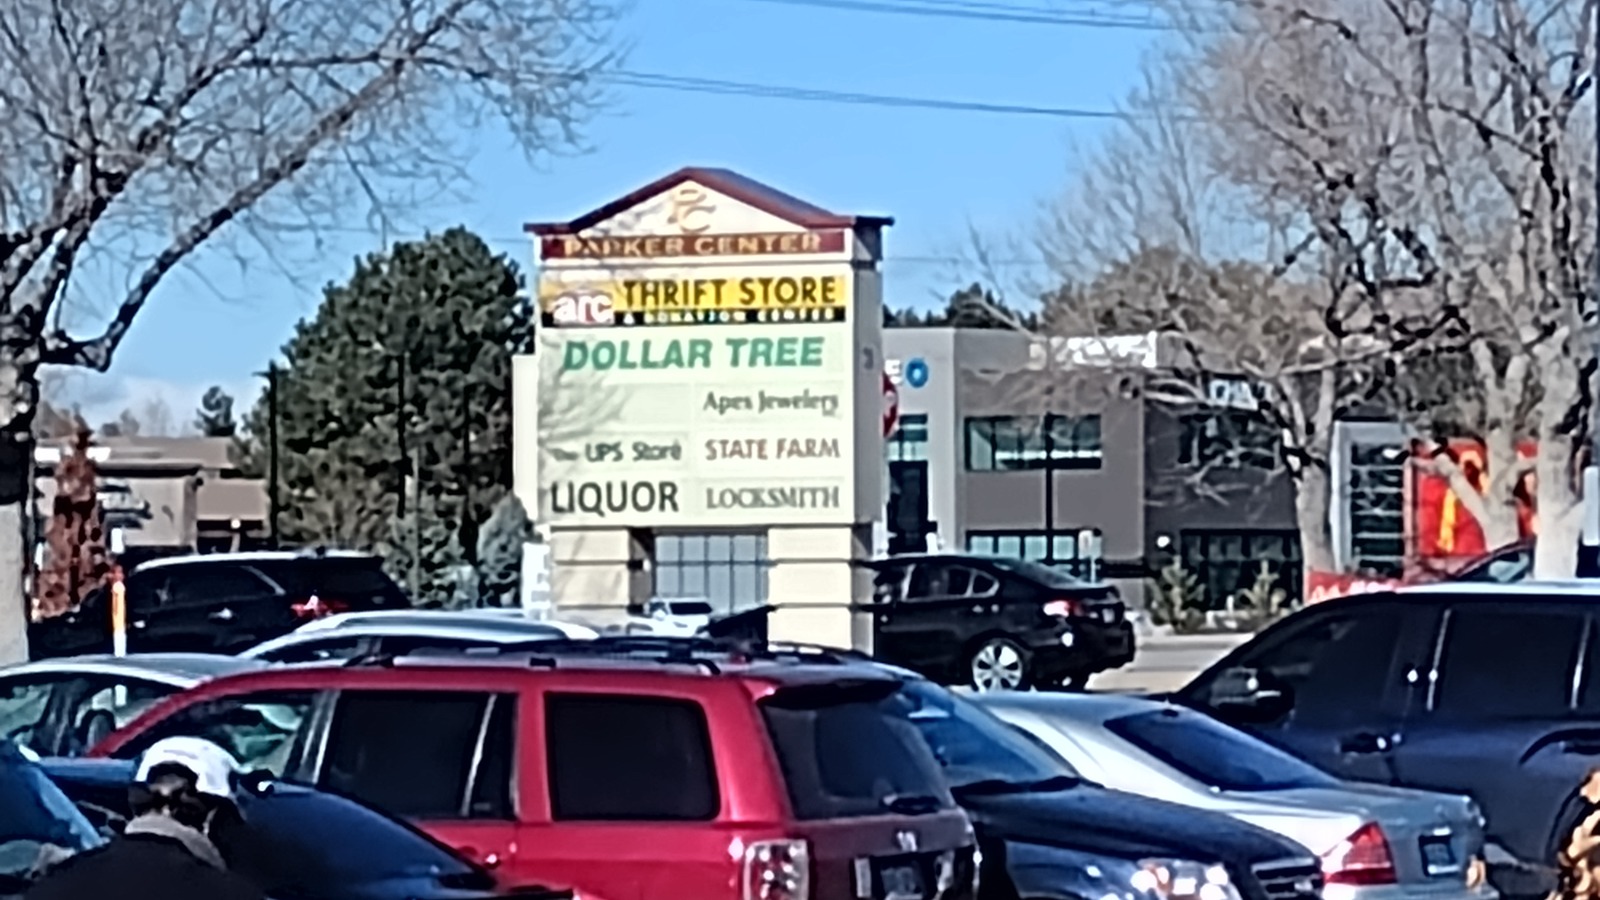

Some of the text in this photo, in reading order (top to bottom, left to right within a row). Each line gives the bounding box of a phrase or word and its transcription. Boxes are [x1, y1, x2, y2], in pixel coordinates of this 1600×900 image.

[564, 233, 821, 257] PARKER CENTER
[623, 276, 837, 307] THRIFT STORE
[553, 294, 614, 324] arc
[563, 338, 714, 371] DOLLAR
[725, 336, 826, 368] TREE
[584, 441, 624, 463] UPS
[632, 439, 682, 462] Store
[704, 437, 841, 461] STATE FARM
[551, 480, 680, 517] LIQUOR
[706, 486, 840, 509] LOCKSMITH
